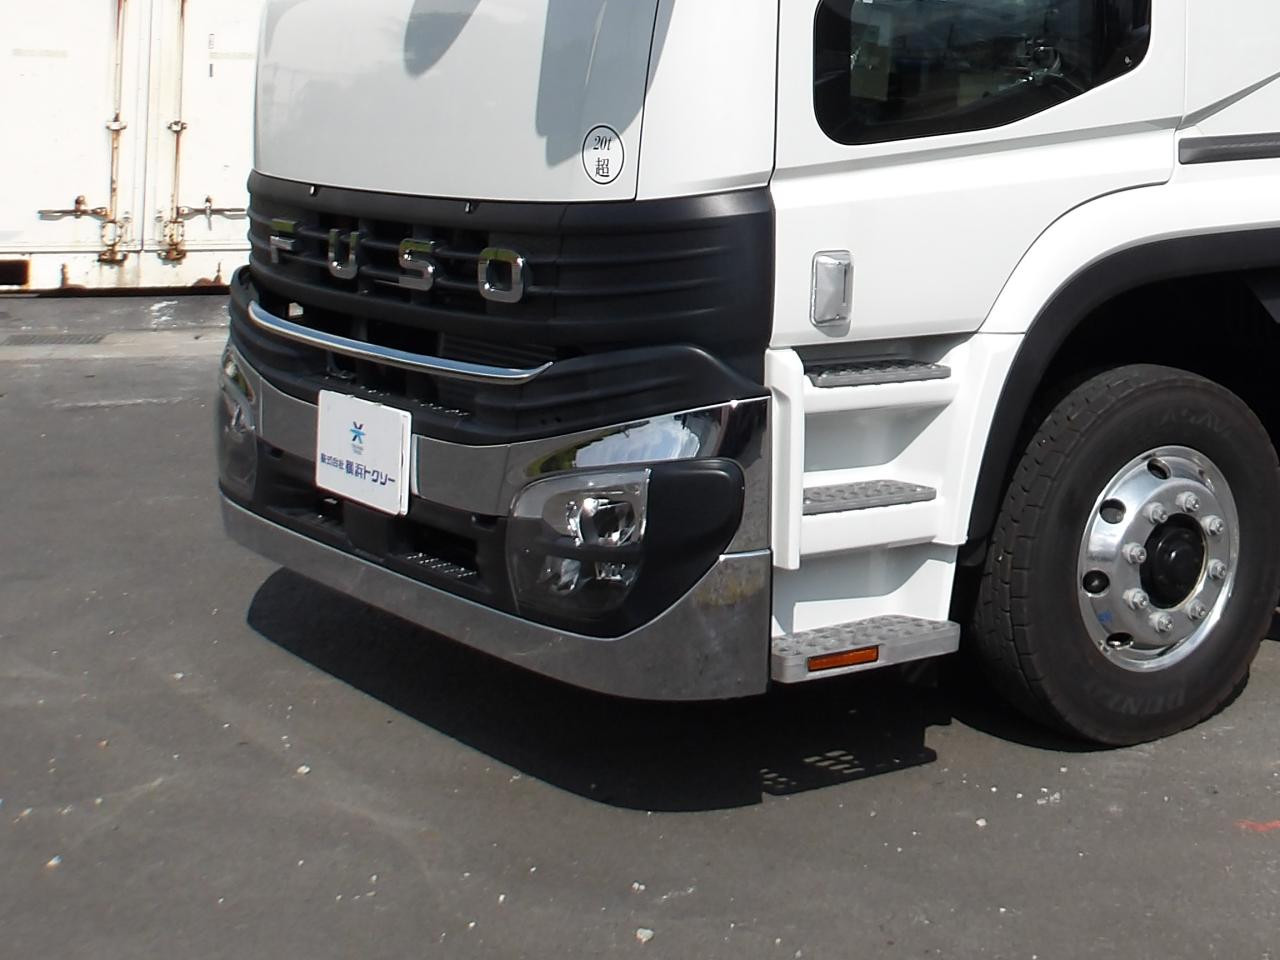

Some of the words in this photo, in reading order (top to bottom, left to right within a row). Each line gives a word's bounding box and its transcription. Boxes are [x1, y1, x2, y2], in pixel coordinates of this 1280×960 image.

[593, 135, 612, 151] 20t
[595, 157, 610, 178] 超
[270, 218, 525, 303] FUSO
